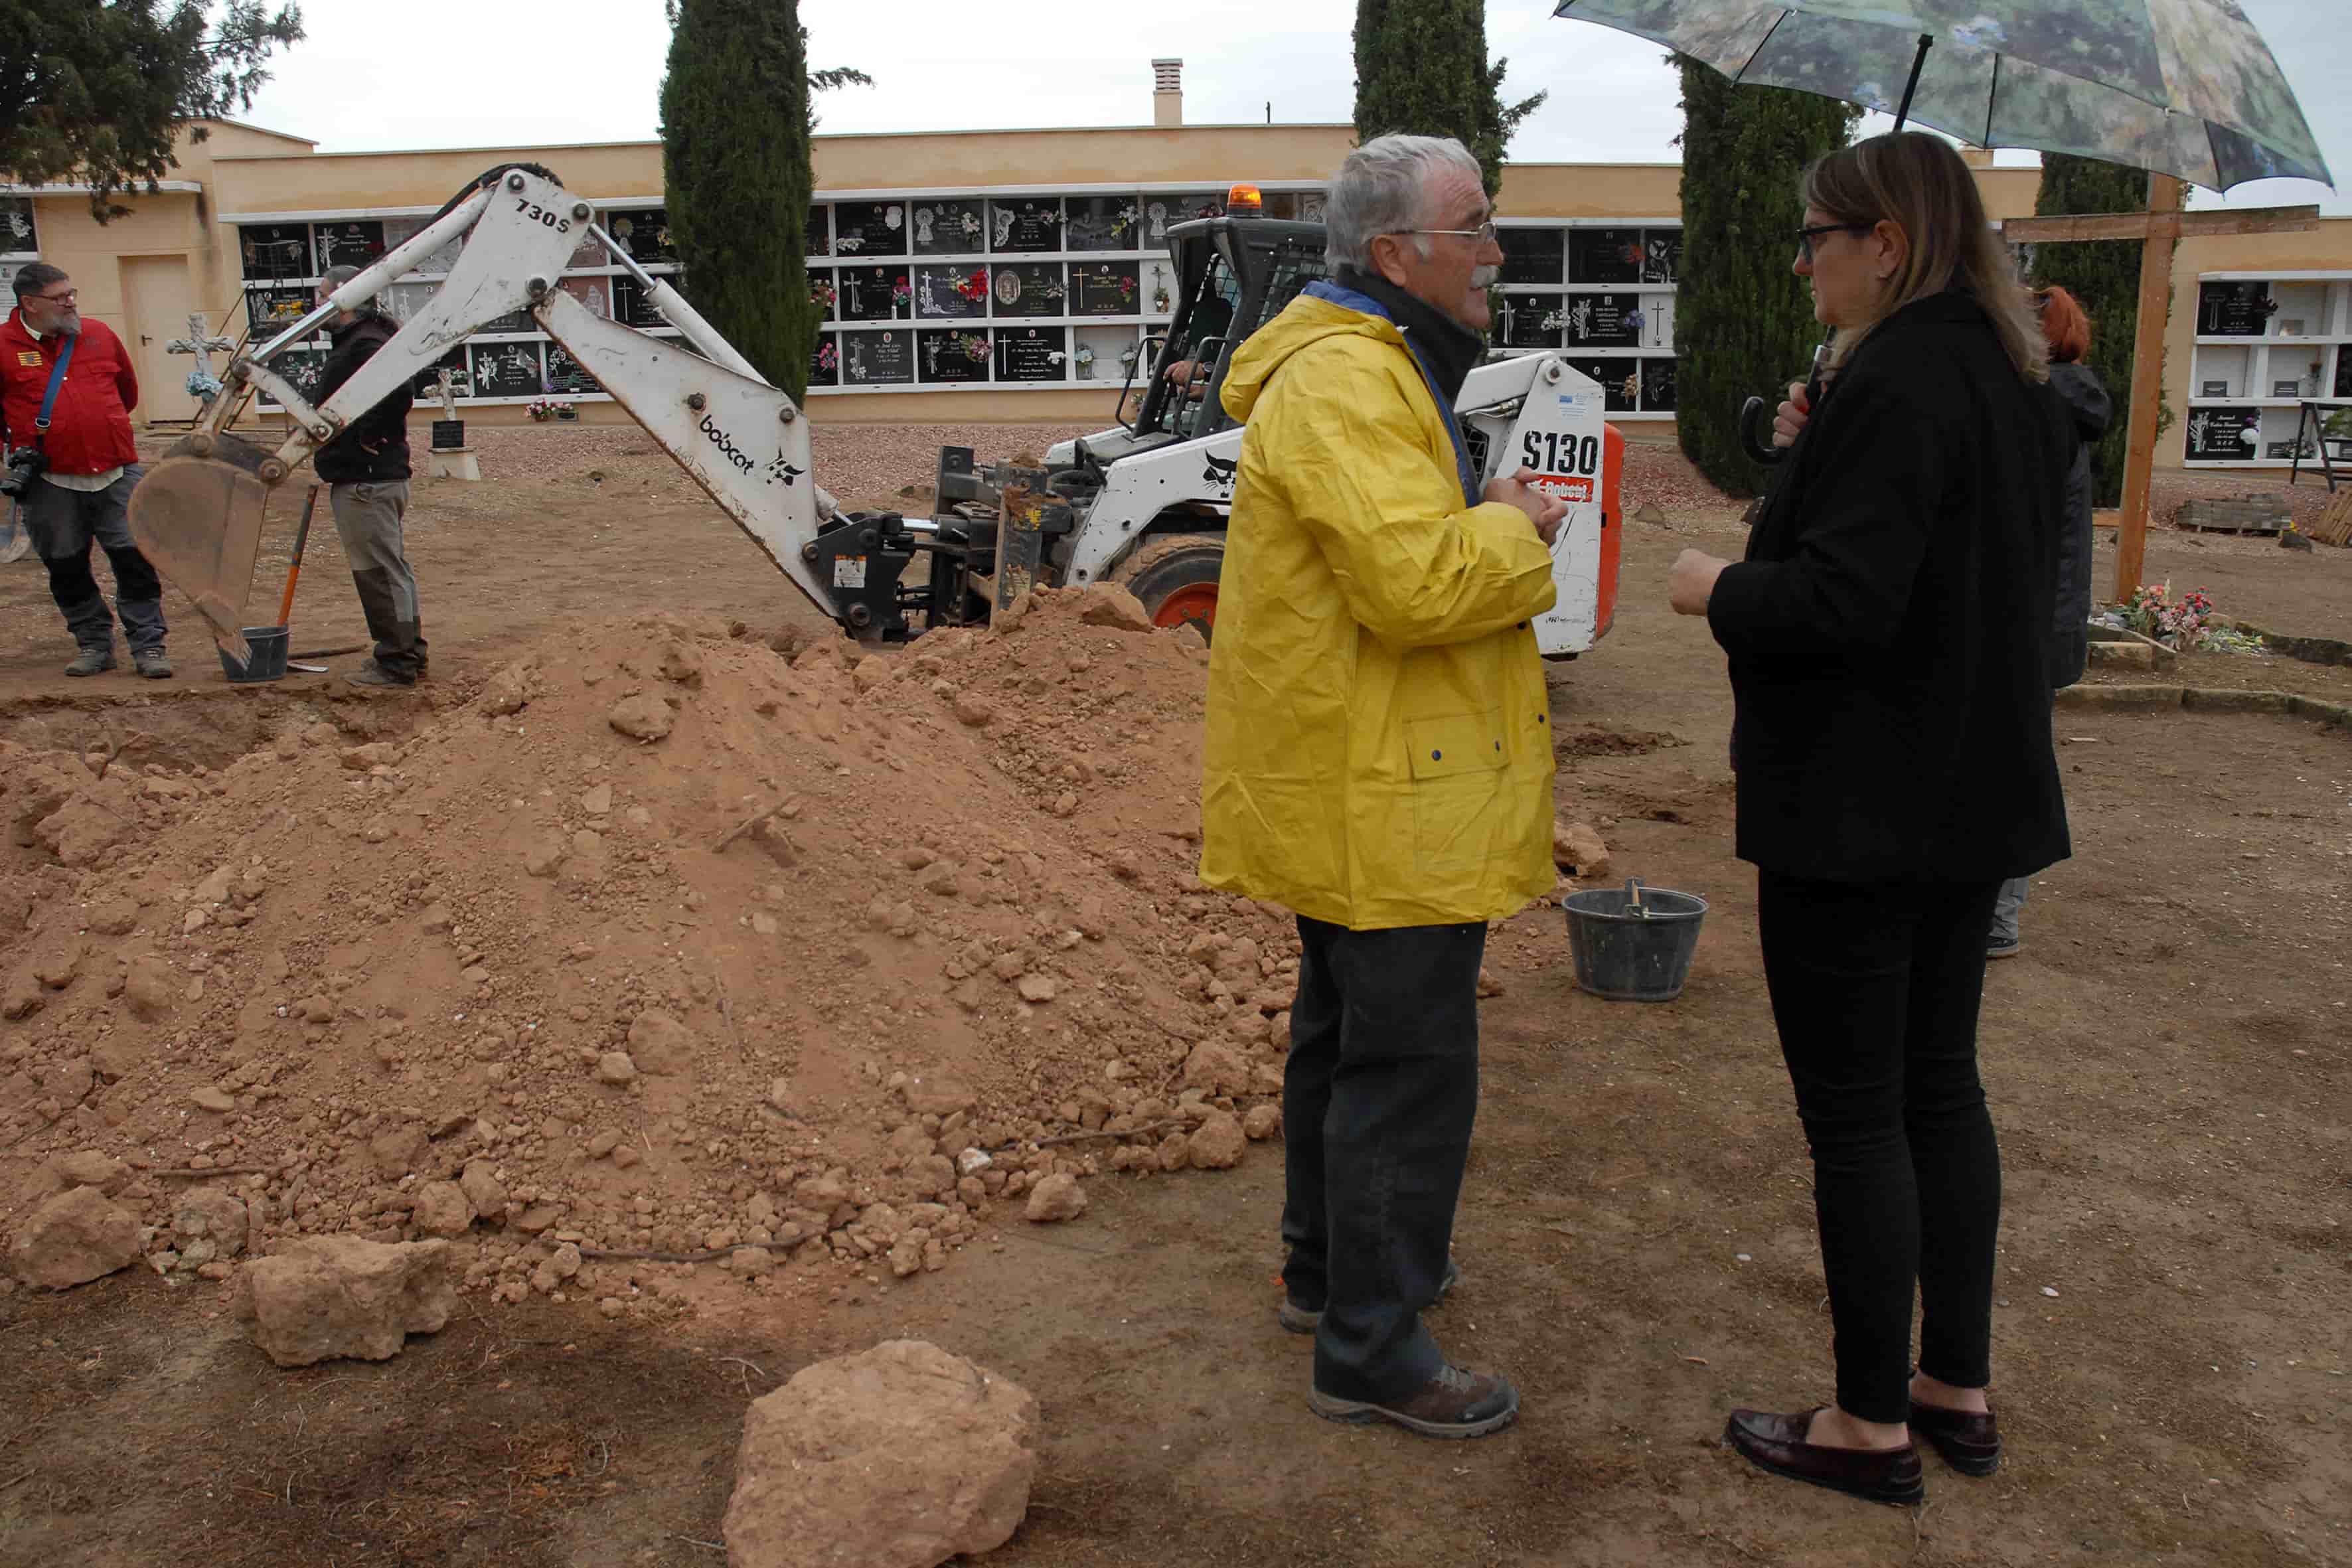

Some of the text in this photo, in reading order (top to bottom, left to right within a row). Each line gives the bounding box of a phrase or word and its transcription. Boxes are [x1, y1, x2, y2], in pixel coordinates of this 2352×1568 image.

[516, 198, 570, 234] 730S
[700, 414, 754, 476] bobcat
[1522, 430, 1598, 475] S130
